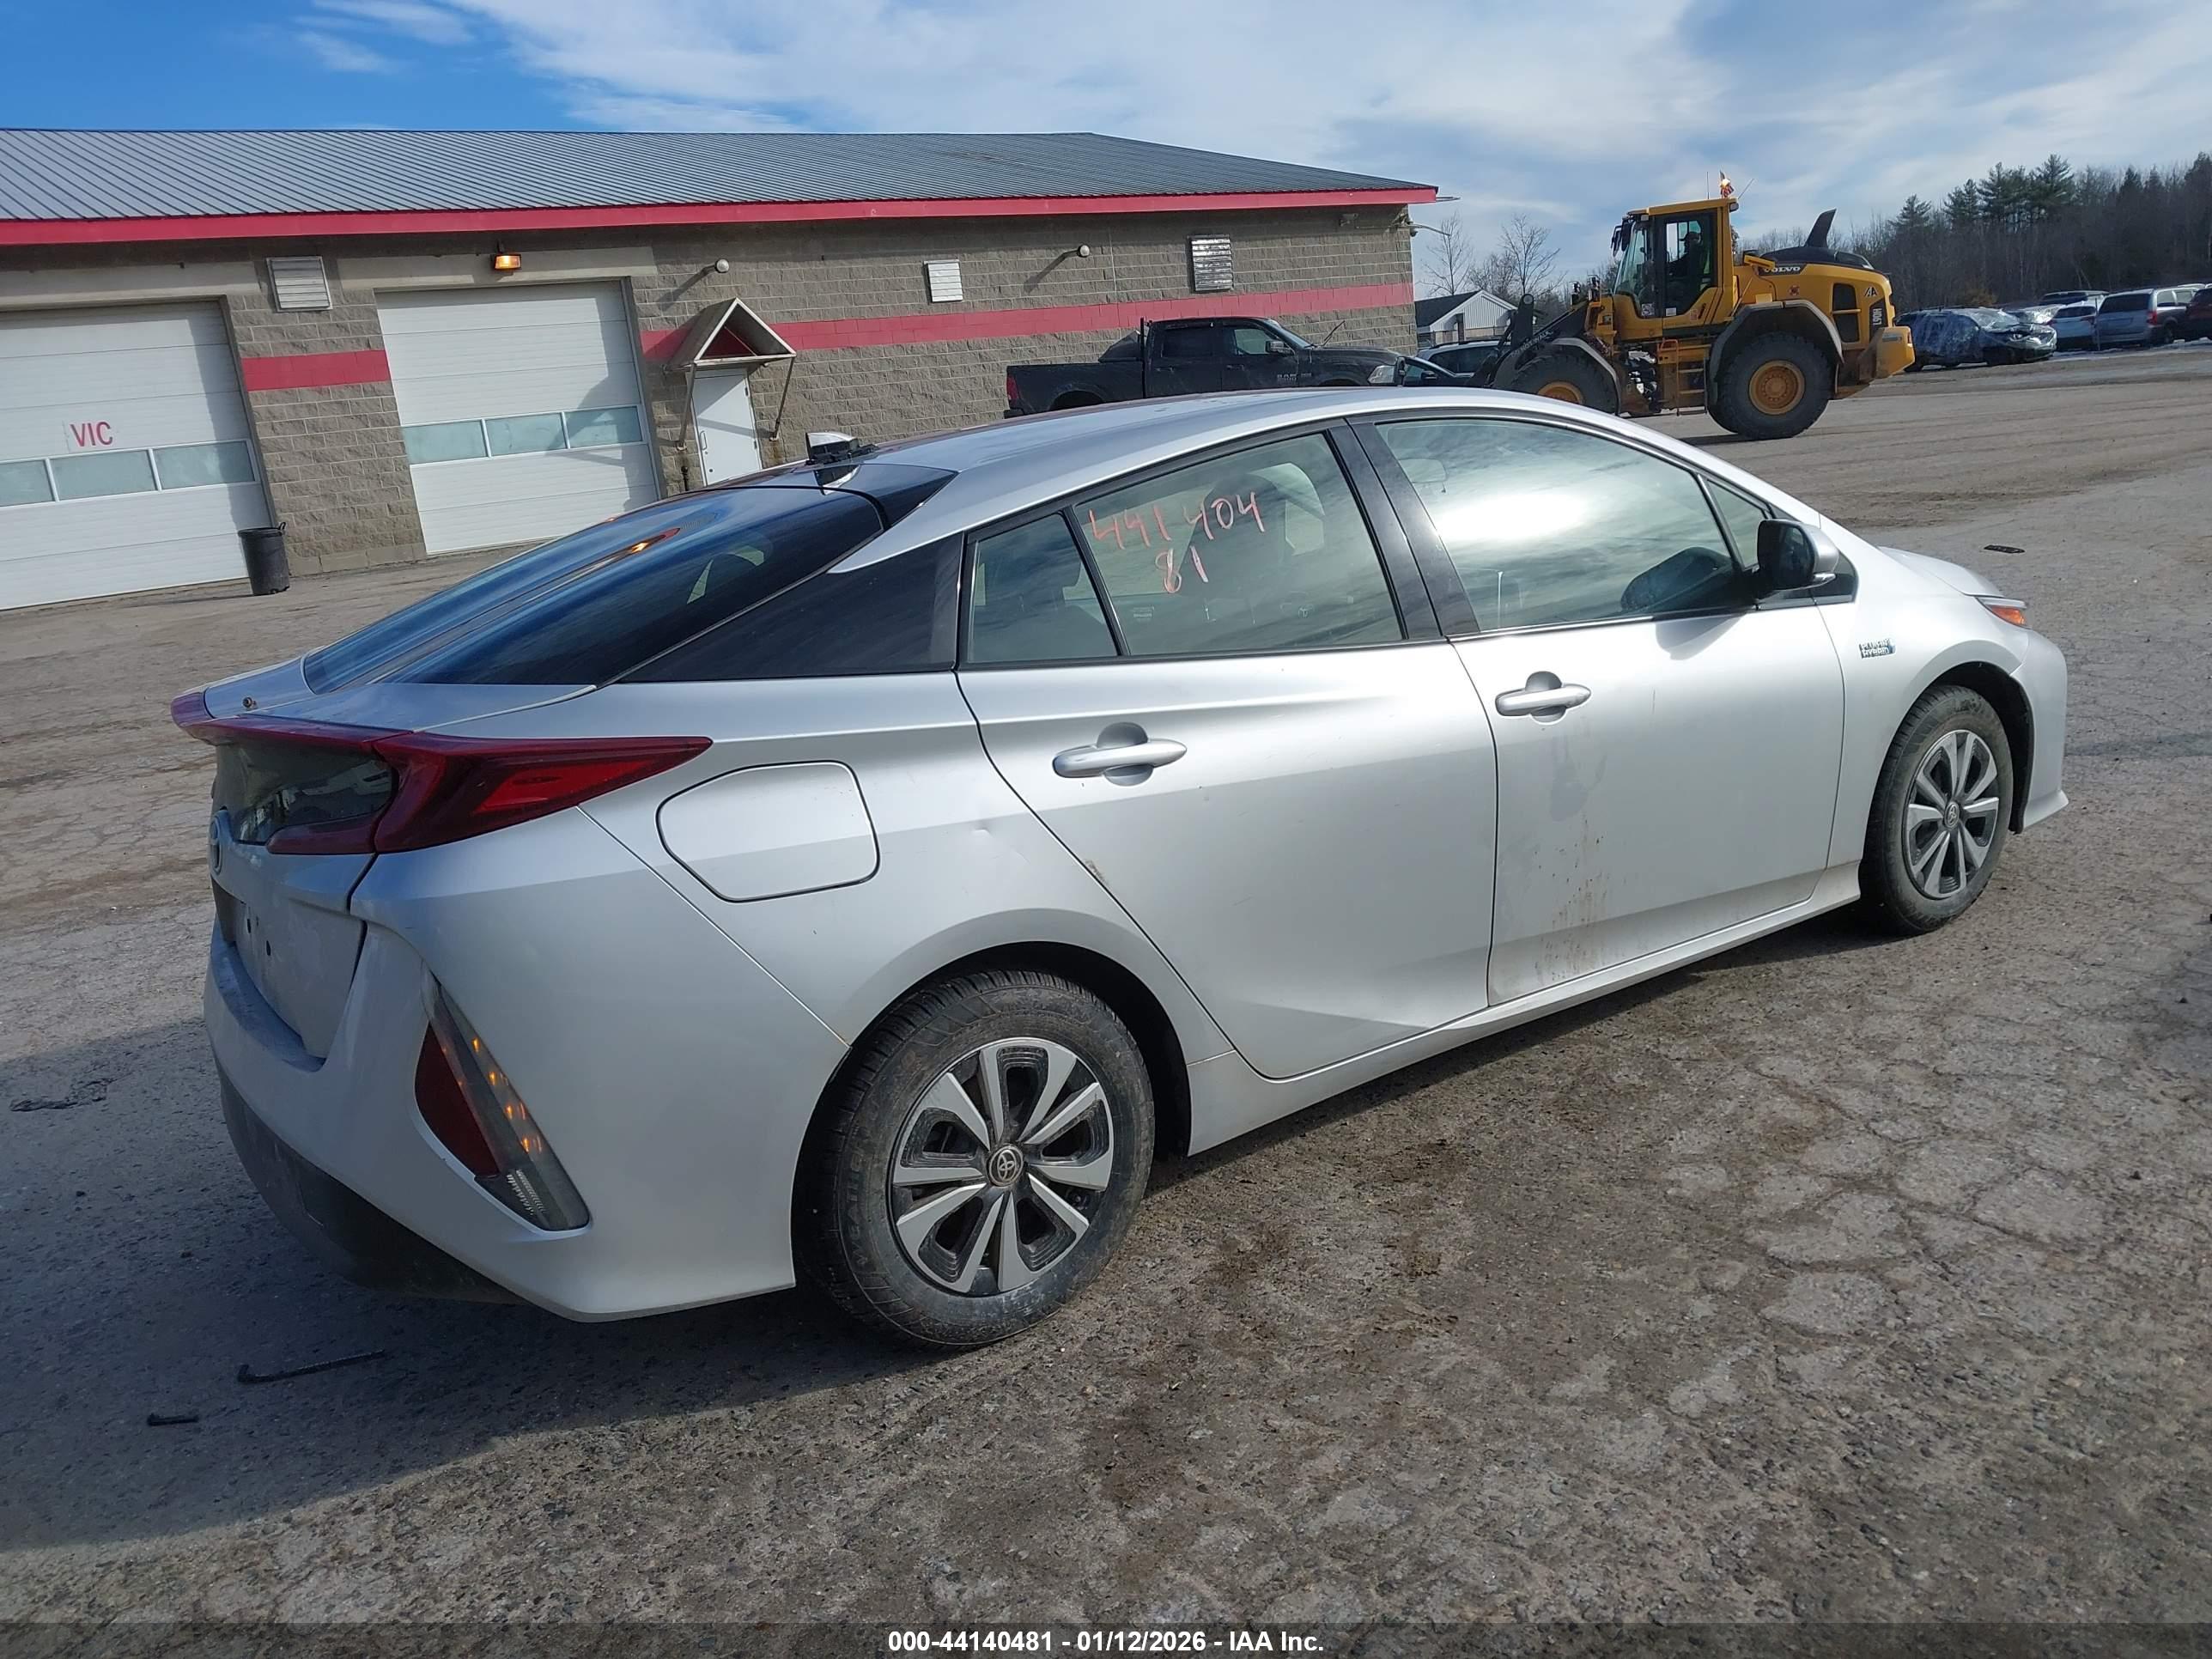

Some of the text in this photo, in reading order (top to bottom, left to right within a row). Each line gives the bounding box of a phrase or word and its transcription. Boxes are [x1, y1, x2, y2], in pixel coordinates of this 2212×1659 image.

[70, 422, 113, 447] VIC
[1089, 492, 1266, 550] 441 404
[1155, 545, 1209, 593] 81
